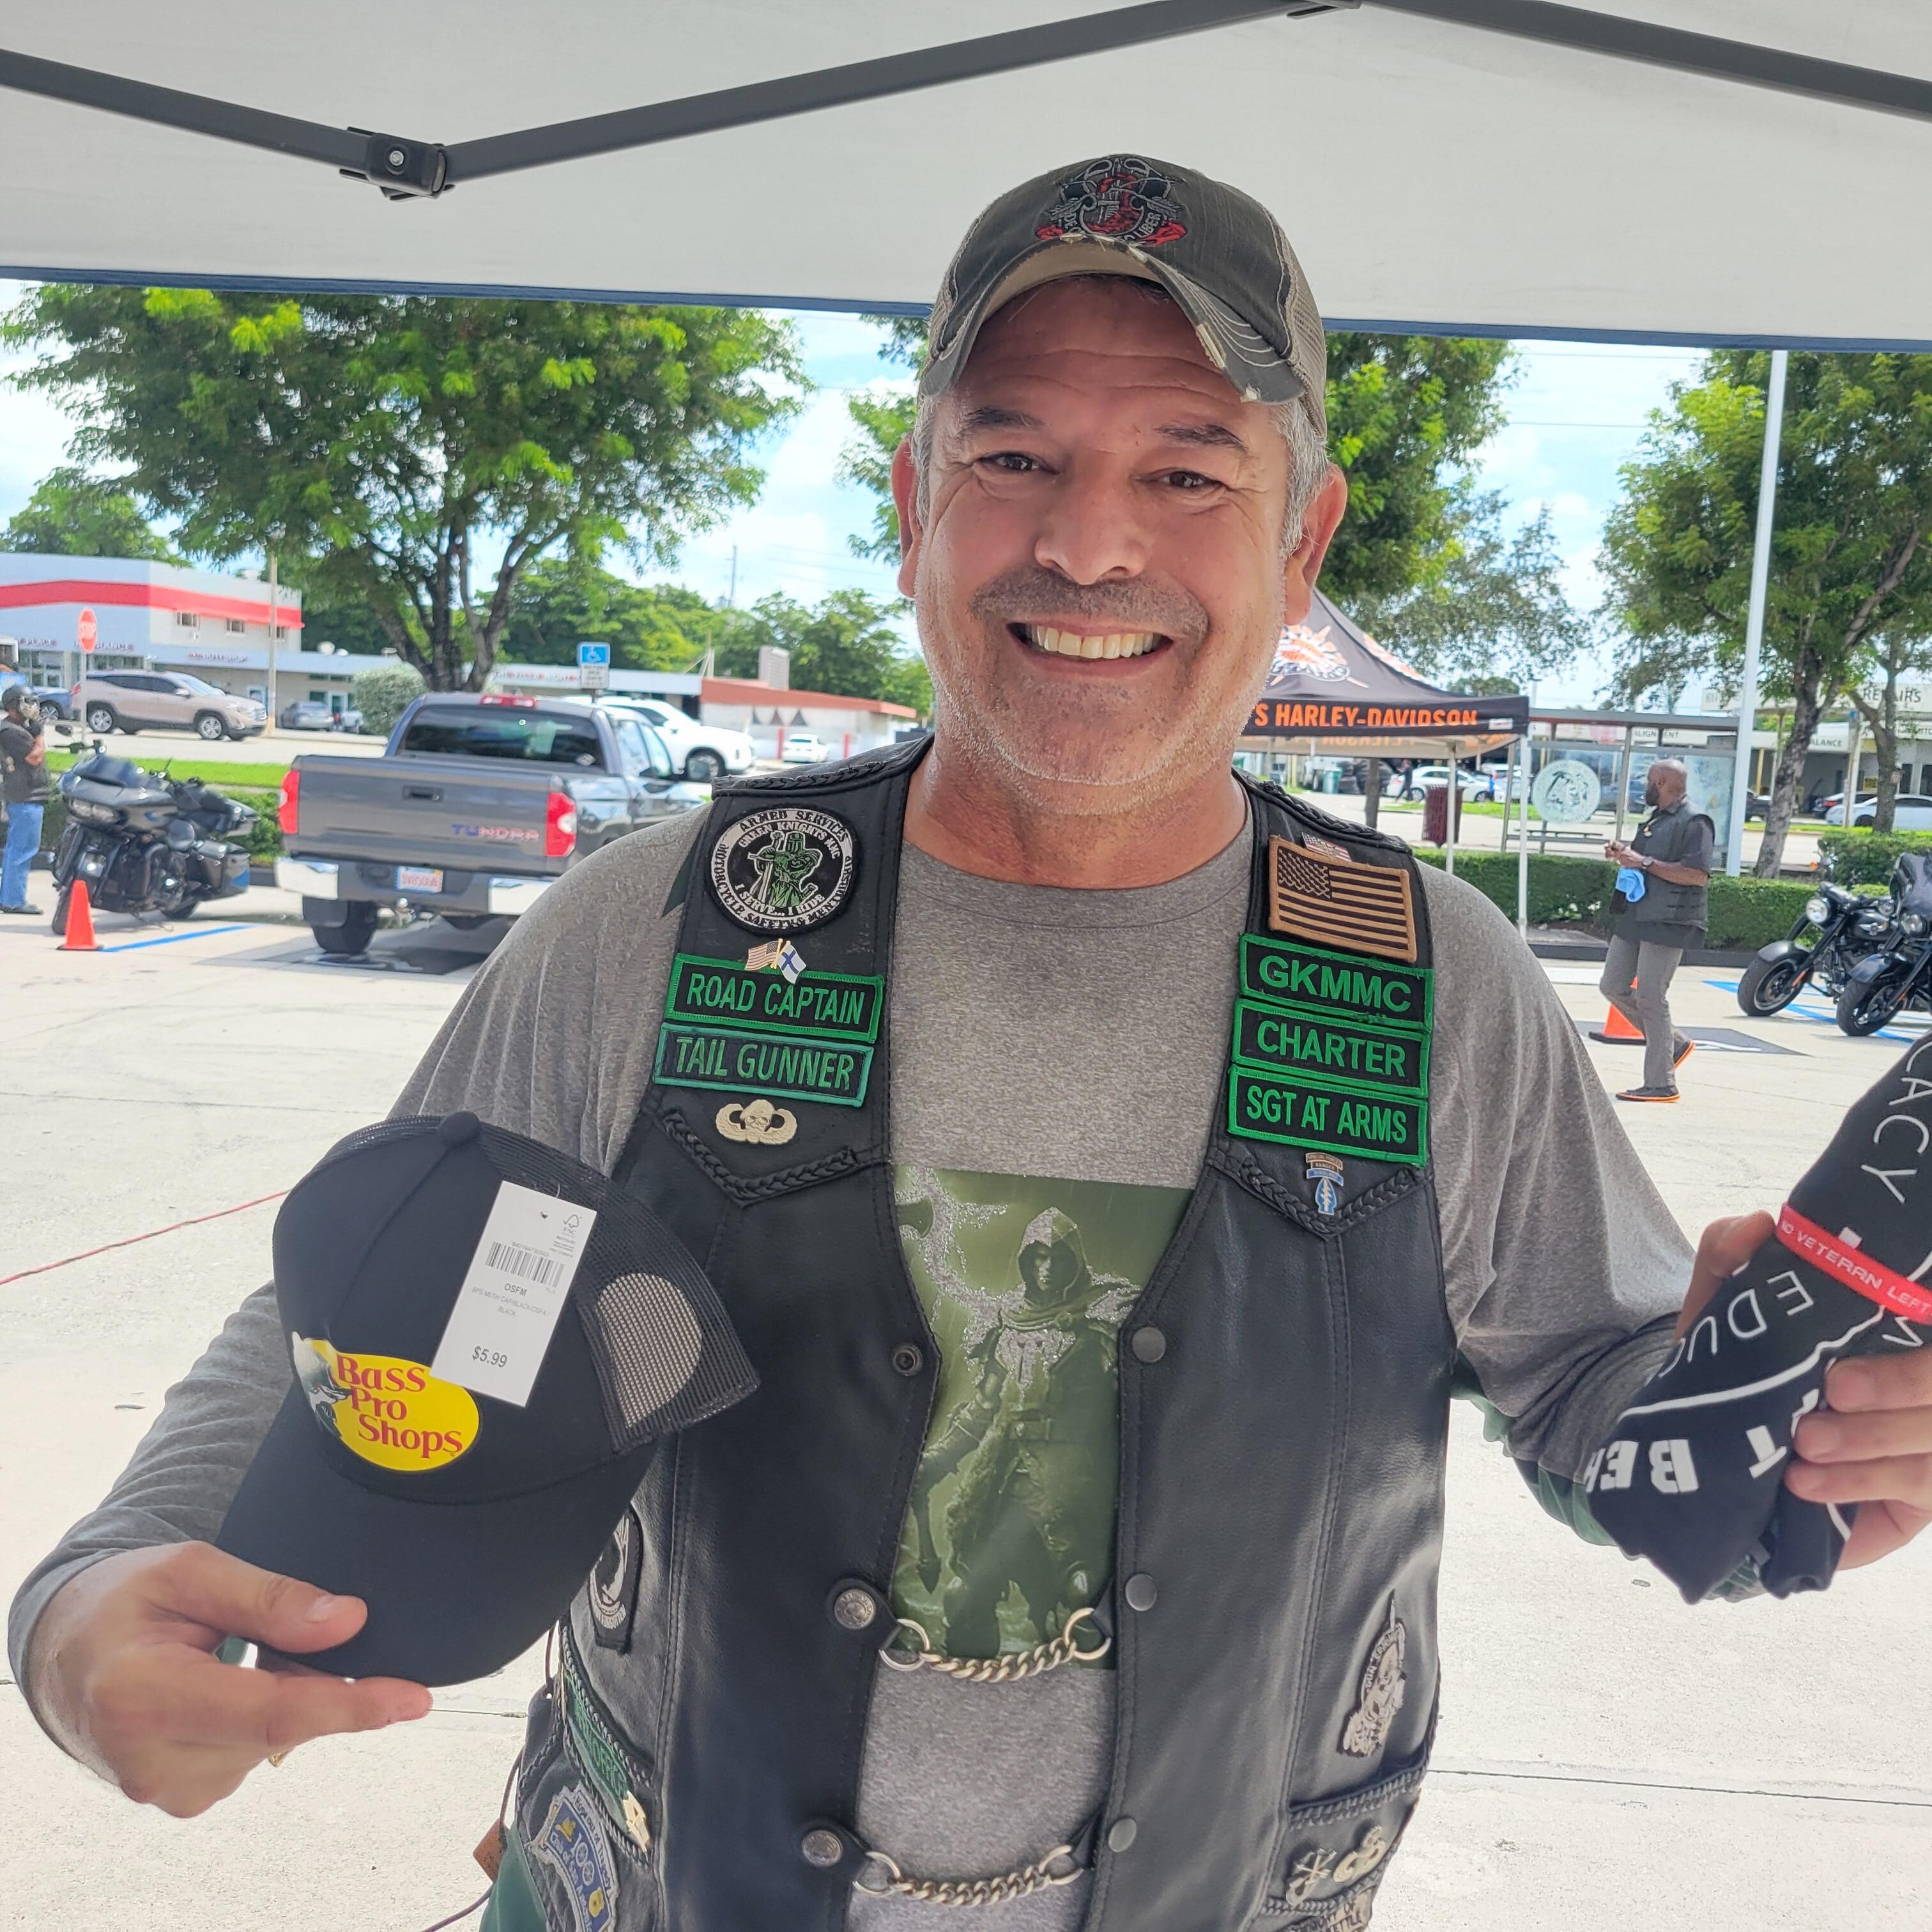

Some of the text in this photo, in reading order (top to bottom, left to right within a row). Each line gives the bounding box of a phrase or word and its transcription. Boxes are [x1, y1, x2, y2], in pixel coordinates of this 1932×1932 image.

[1133, 211, 1161, 238] LIBER
[80, 622, 96, 638] STOP
[1863, 689, 1921, 703] REIRS
[1275, 703, 1477, 727] HARLEY-DAVIDSON
[452, 824, 539, 842] TUNDRA
[738, 823, 774, 848] GREEN
[778, 821, 827, 840] KNIGHTS
[740, 810, 847, 842] ARMED SERVICES
[714, 843, 745, 914] MOTORCYCLE
[787, 905, 793, 916] I
[797, 894, 825, 914] RIDE
[687, 972, 865, 1025] ROAD CAPTAIN
[1259, 954, 1411, 1013] GKMMC
[676, 1036, 854, 1089] TAIL GUNNER
[1257, 1020, 1406, 1078] CHARTER
[1246, 1085, 1406, 1144] SGT AT ARMS
[505, 1283, 526, 1296] OSFM
[1797, 1230, 1883, 1289] VETERAN
[1887, 1285, 1931, 1314] LEFT
[337, 1354, 425, 1392] Bass
[472, 1346, 507, 1368] $5.99
[350, 1385, 407, 1420] Pro
[358, 1413, 463, 1459] Shops
[550, 1832, 564, 1853] Club
[569, 1860, 579, 1885] San
